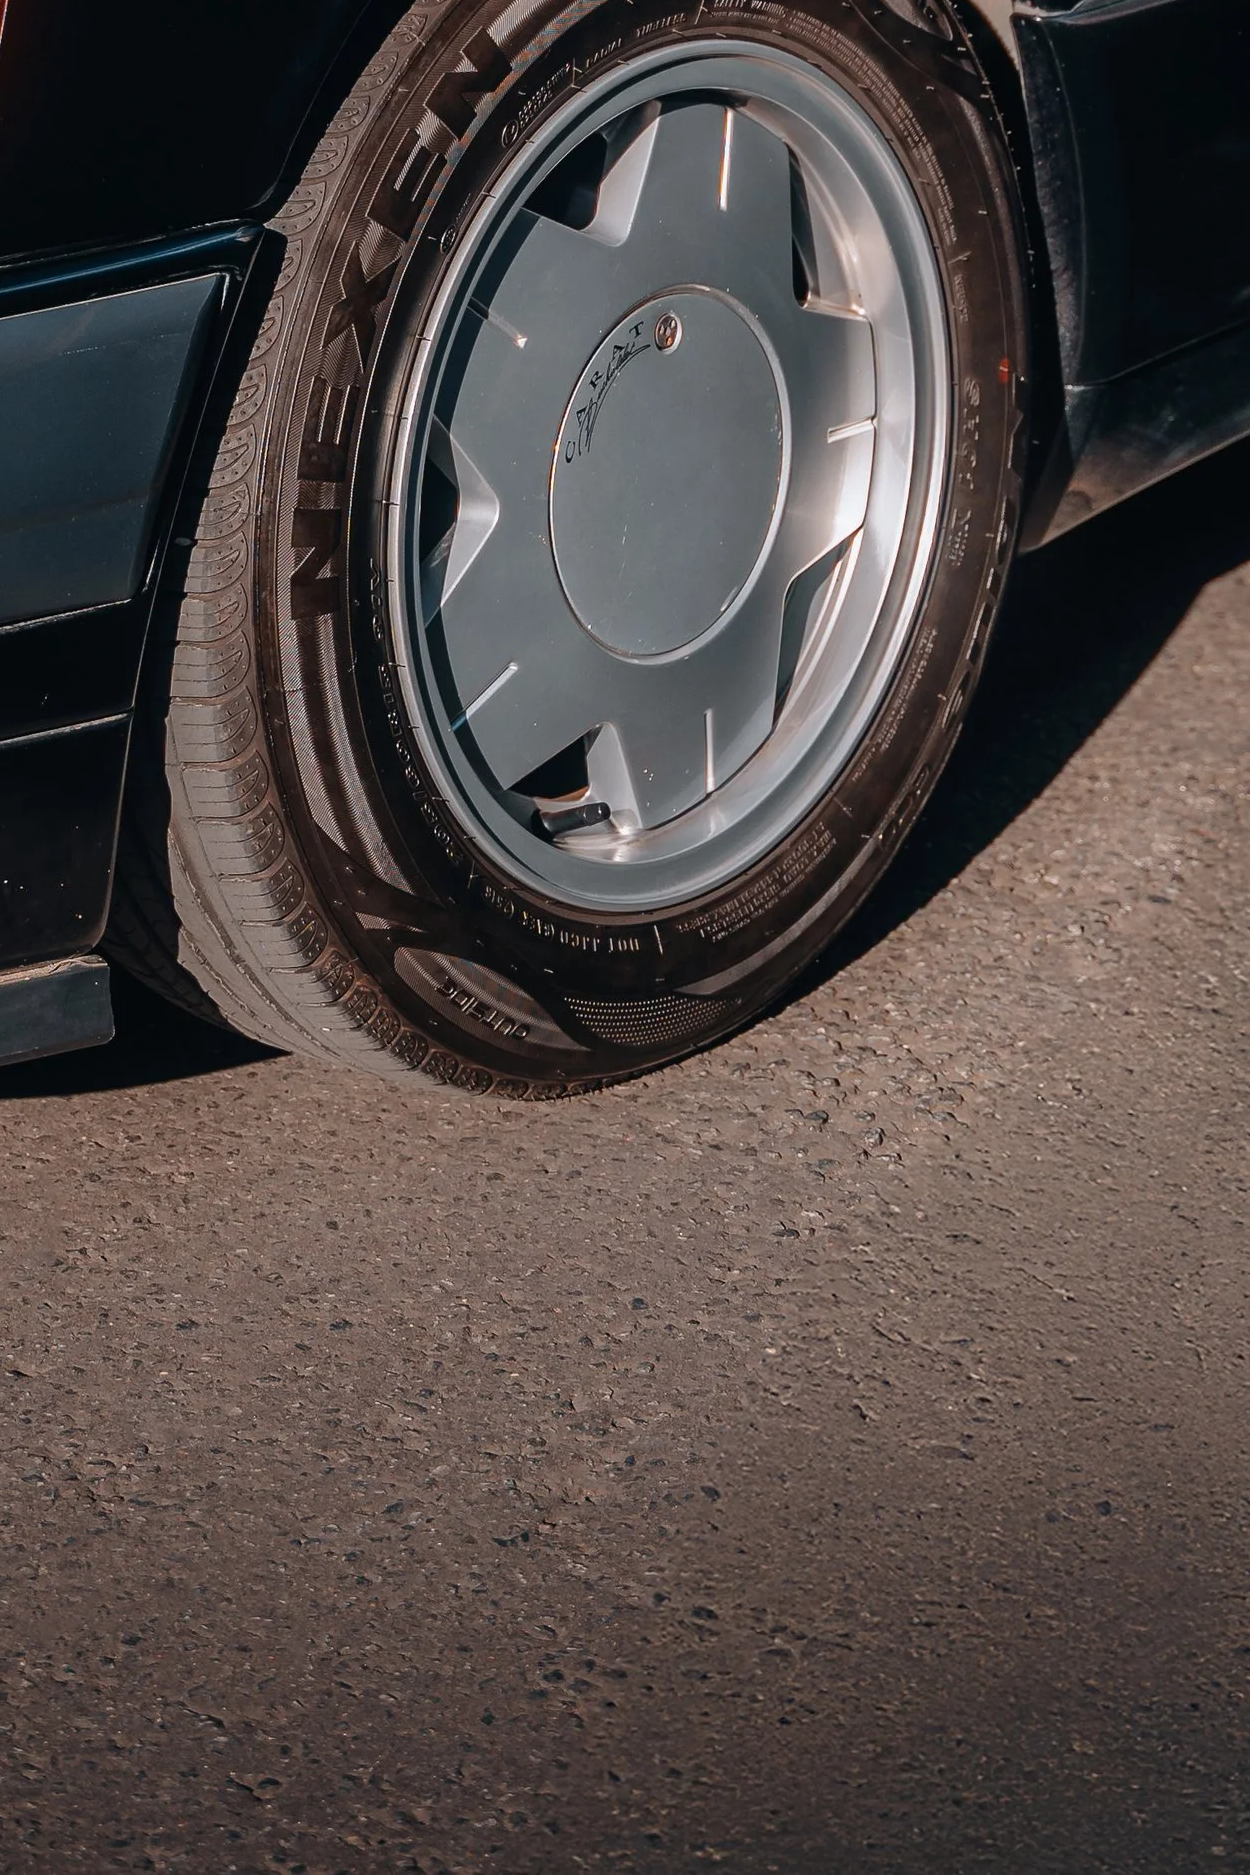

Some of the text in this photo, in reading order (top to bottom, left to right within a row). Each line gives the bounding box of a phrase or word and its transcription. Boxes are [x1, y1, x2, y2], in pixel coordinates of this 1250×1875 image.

[291, 27, 514, 621] NEXEN
[565, 321, 644, 463] CARAT
[436, 975, 531, 1043] OUTSIDE
